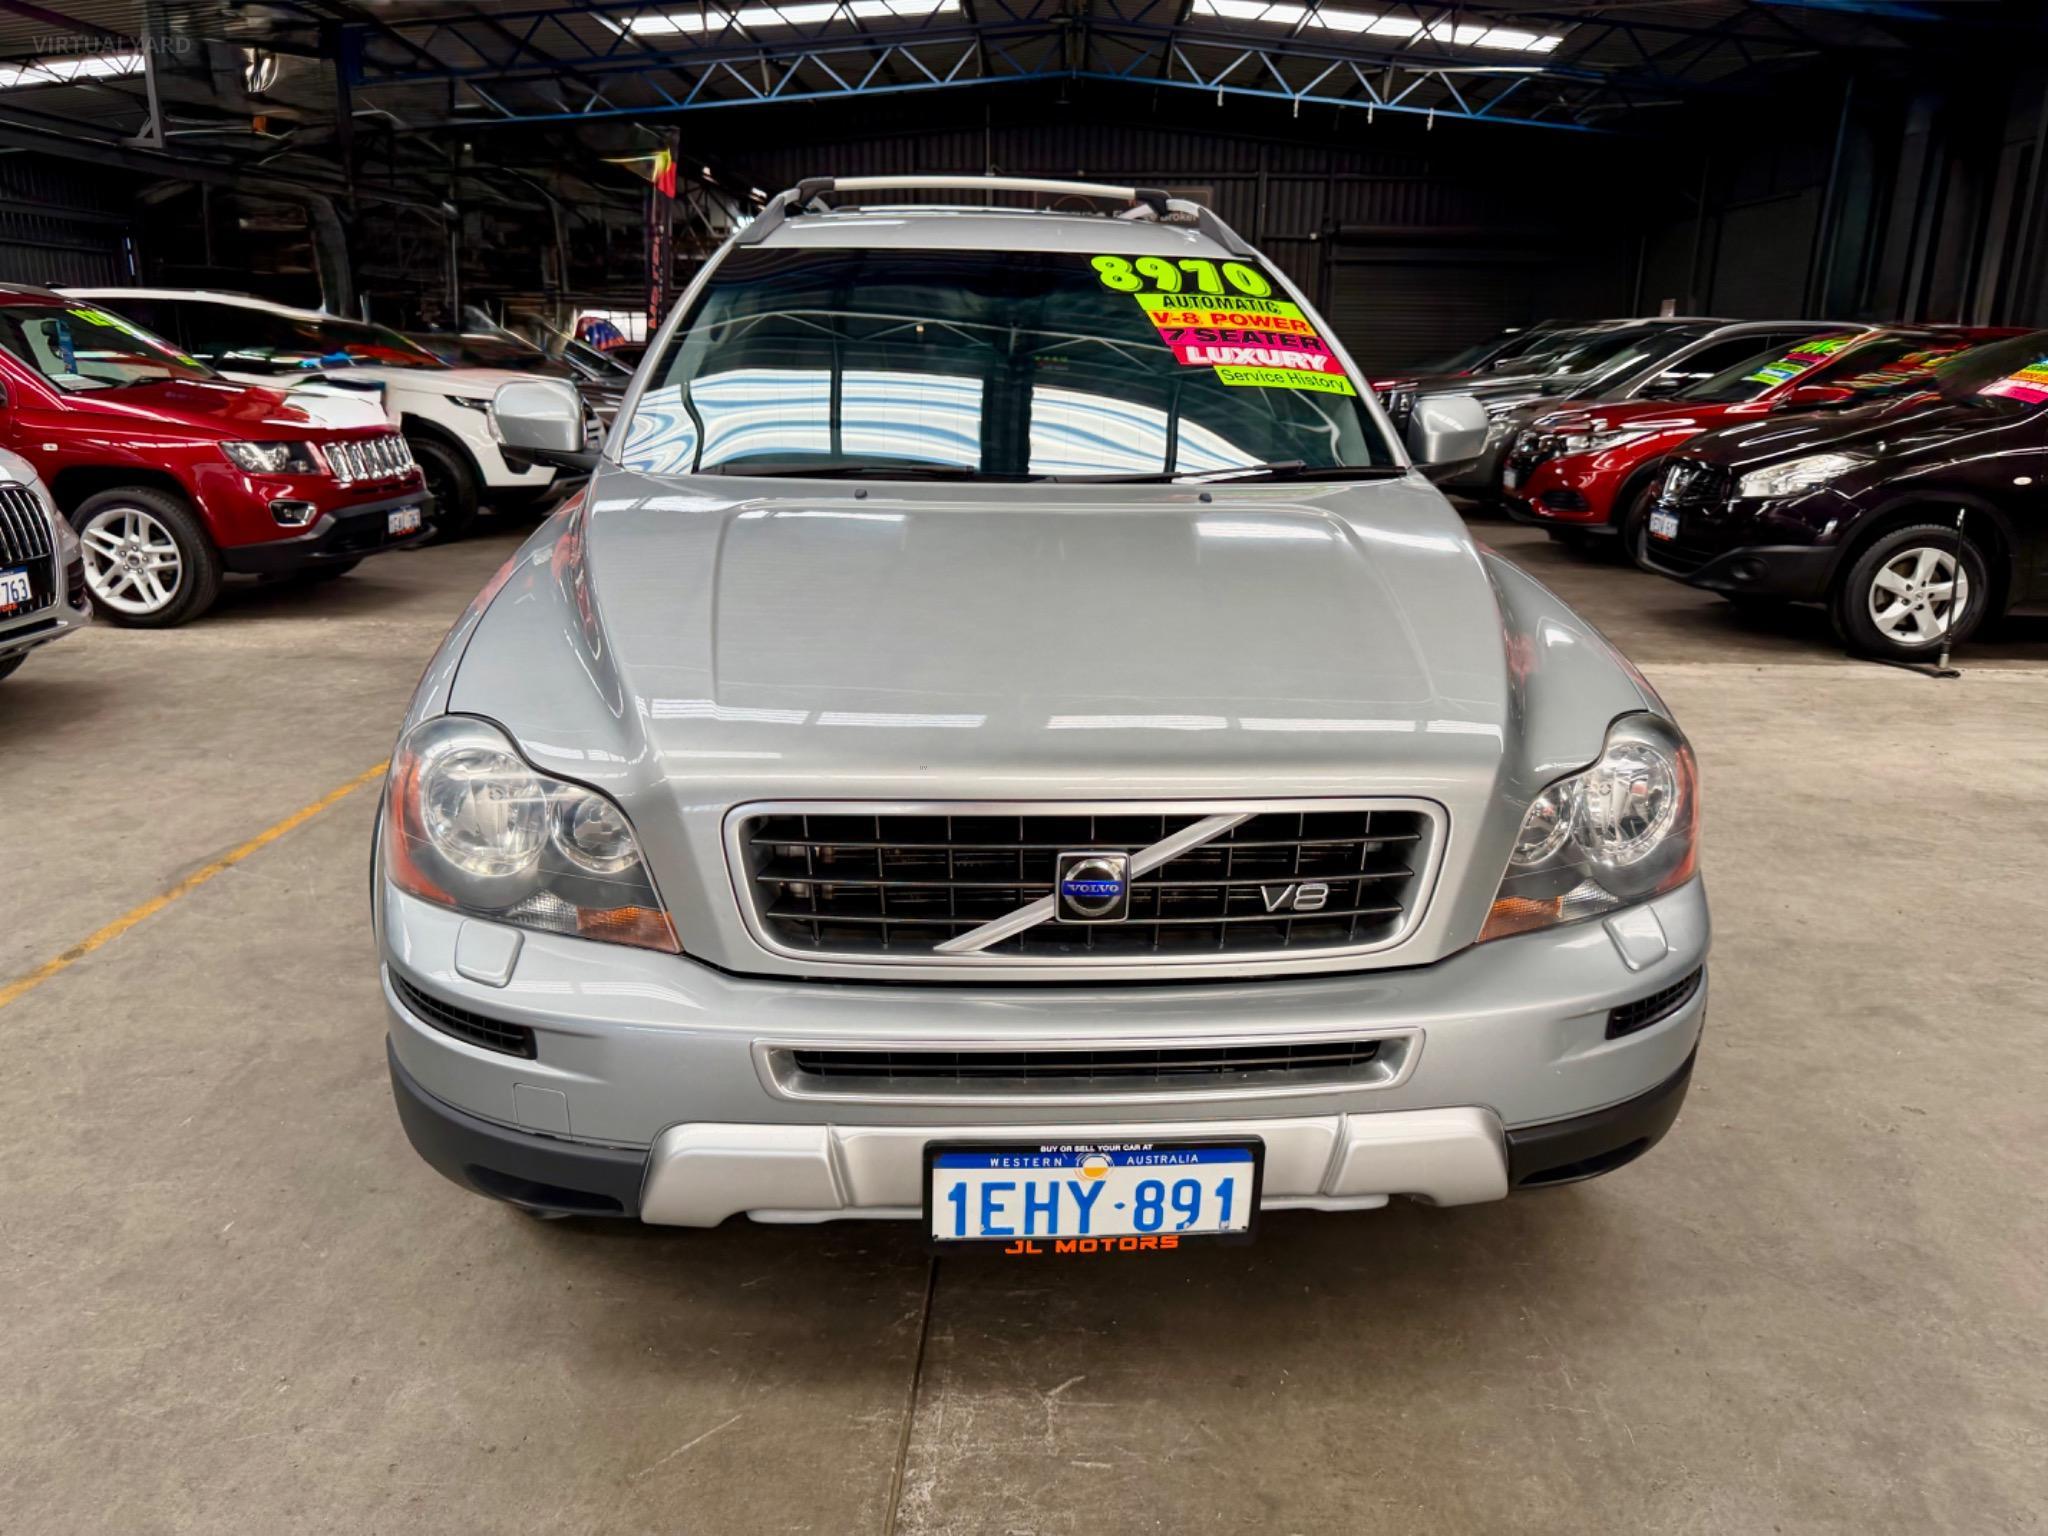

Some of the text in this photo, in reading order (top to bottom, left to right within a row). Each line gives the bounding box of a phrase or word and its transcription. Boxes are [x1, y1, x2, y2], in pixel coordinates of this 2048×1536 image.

[1090, 255, 1272, 297] 8970
[1162, 294, 1283, 315] AUTOMATIC
[1210, 313, 1308, 331] POWER
[1167, 327, 1322, 350] 7 SEATER
[1186, 345, 1328, 371] LUXURY
[1222, 368, 1346, 390] Service History
[1, 578, 28, 602] 763
[1066, 883, 1121, 894] VOLVO
[1260, 883, 1329, 912] V8
[1040, 1145, 1058, 1153] BUY
[1060, 1145, 1073, 1153] OR
[1074, 1145, 1095, 1153] SELL
[989, 1153, 1200, 1168] WESTERN AUSTRALIA
[1004, 1235, 1179, 1255] JL MOTORS
